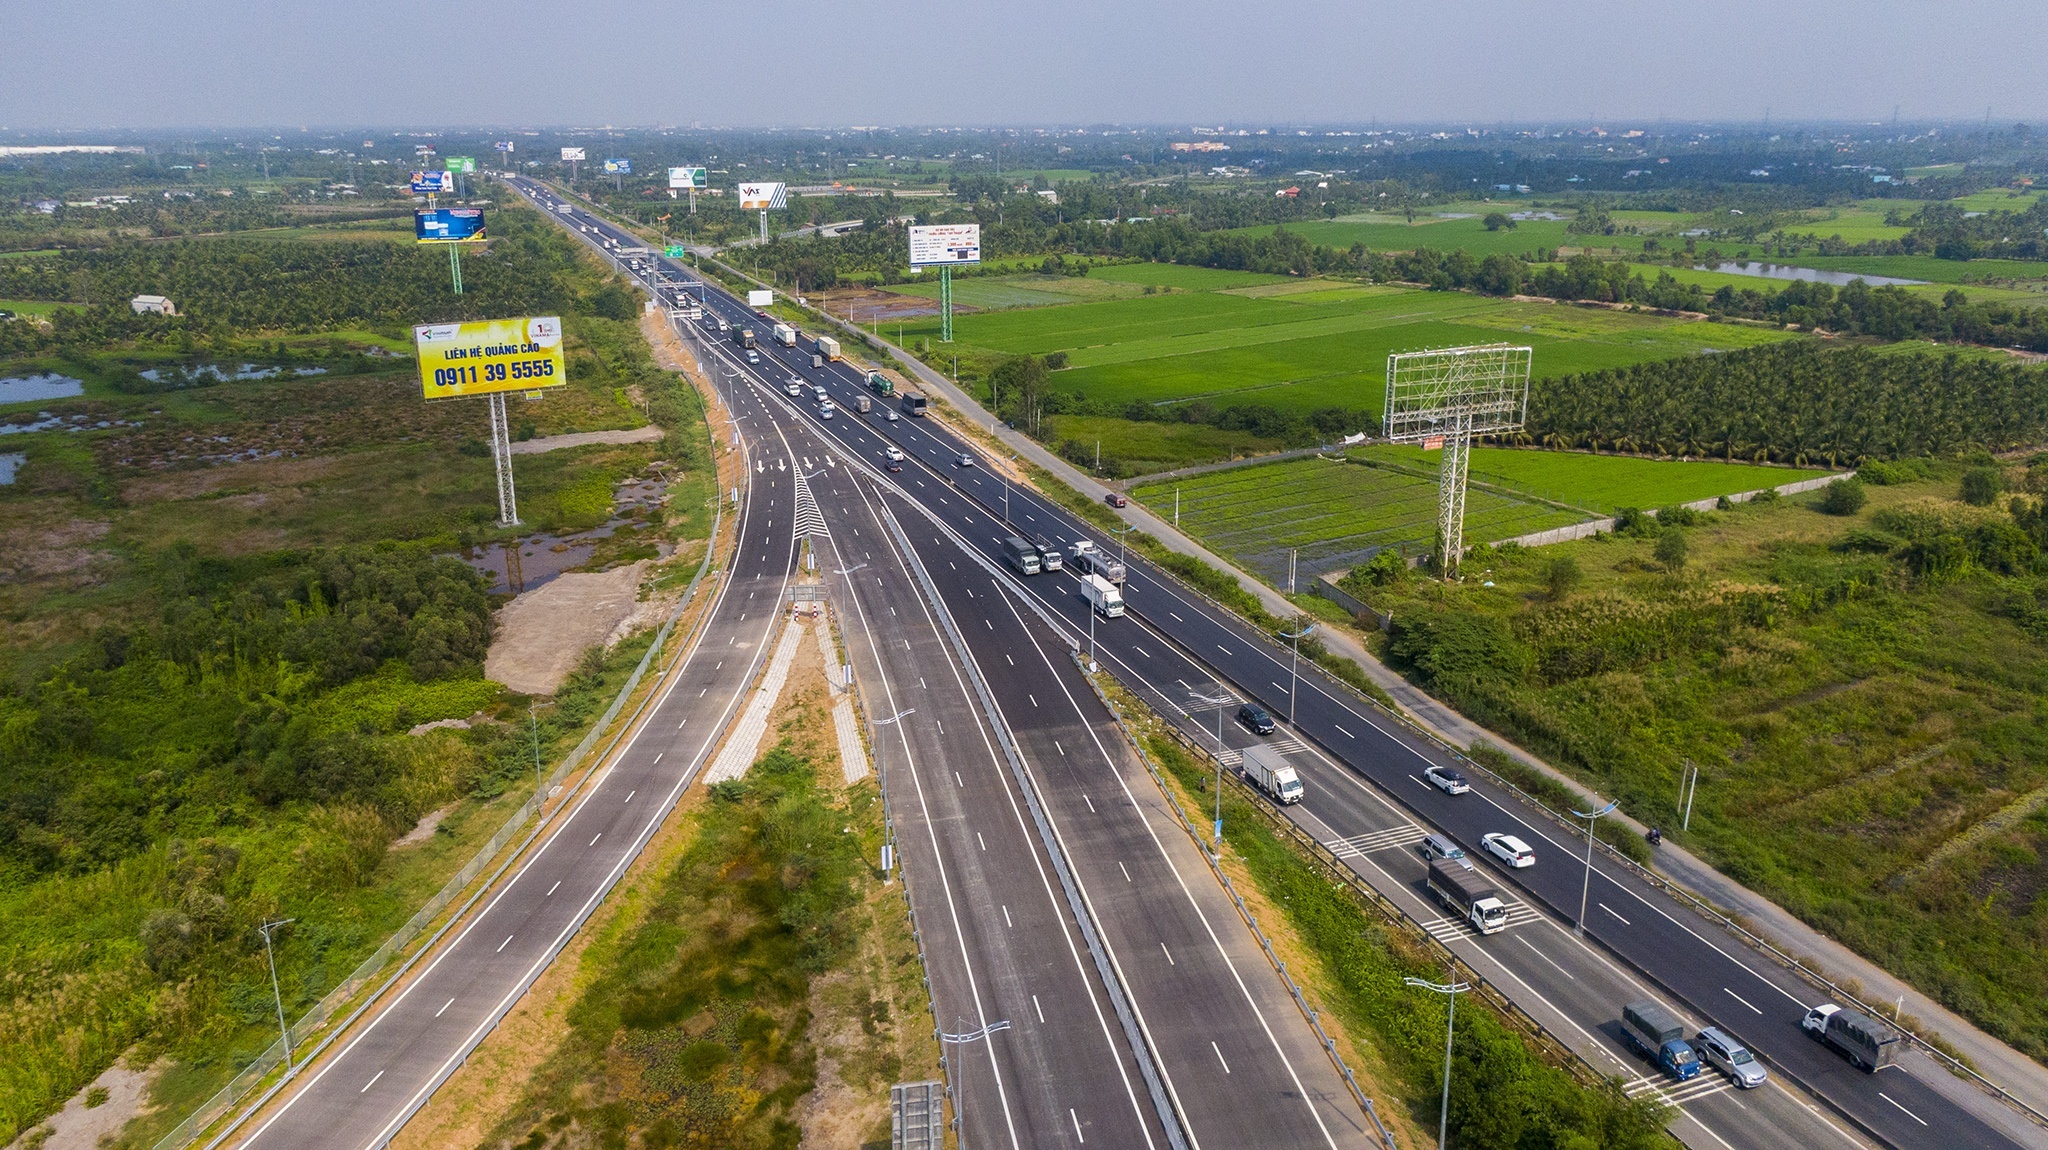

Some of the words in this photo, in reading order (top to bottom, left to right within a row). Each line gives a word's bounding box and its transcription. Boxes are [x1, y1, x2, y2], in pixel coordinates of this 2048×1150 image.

[444, 347, 467, 360] LIÊN
[470, 345, 482, 360] HỆ
[485, 343, 518, 357] QUẢNG
[520, 342, 540, 353] CÁO
[434, 366, 478, 386] 0911
[484, 364, 506, 382] 39
[511, 359, 554, 379] 5555
